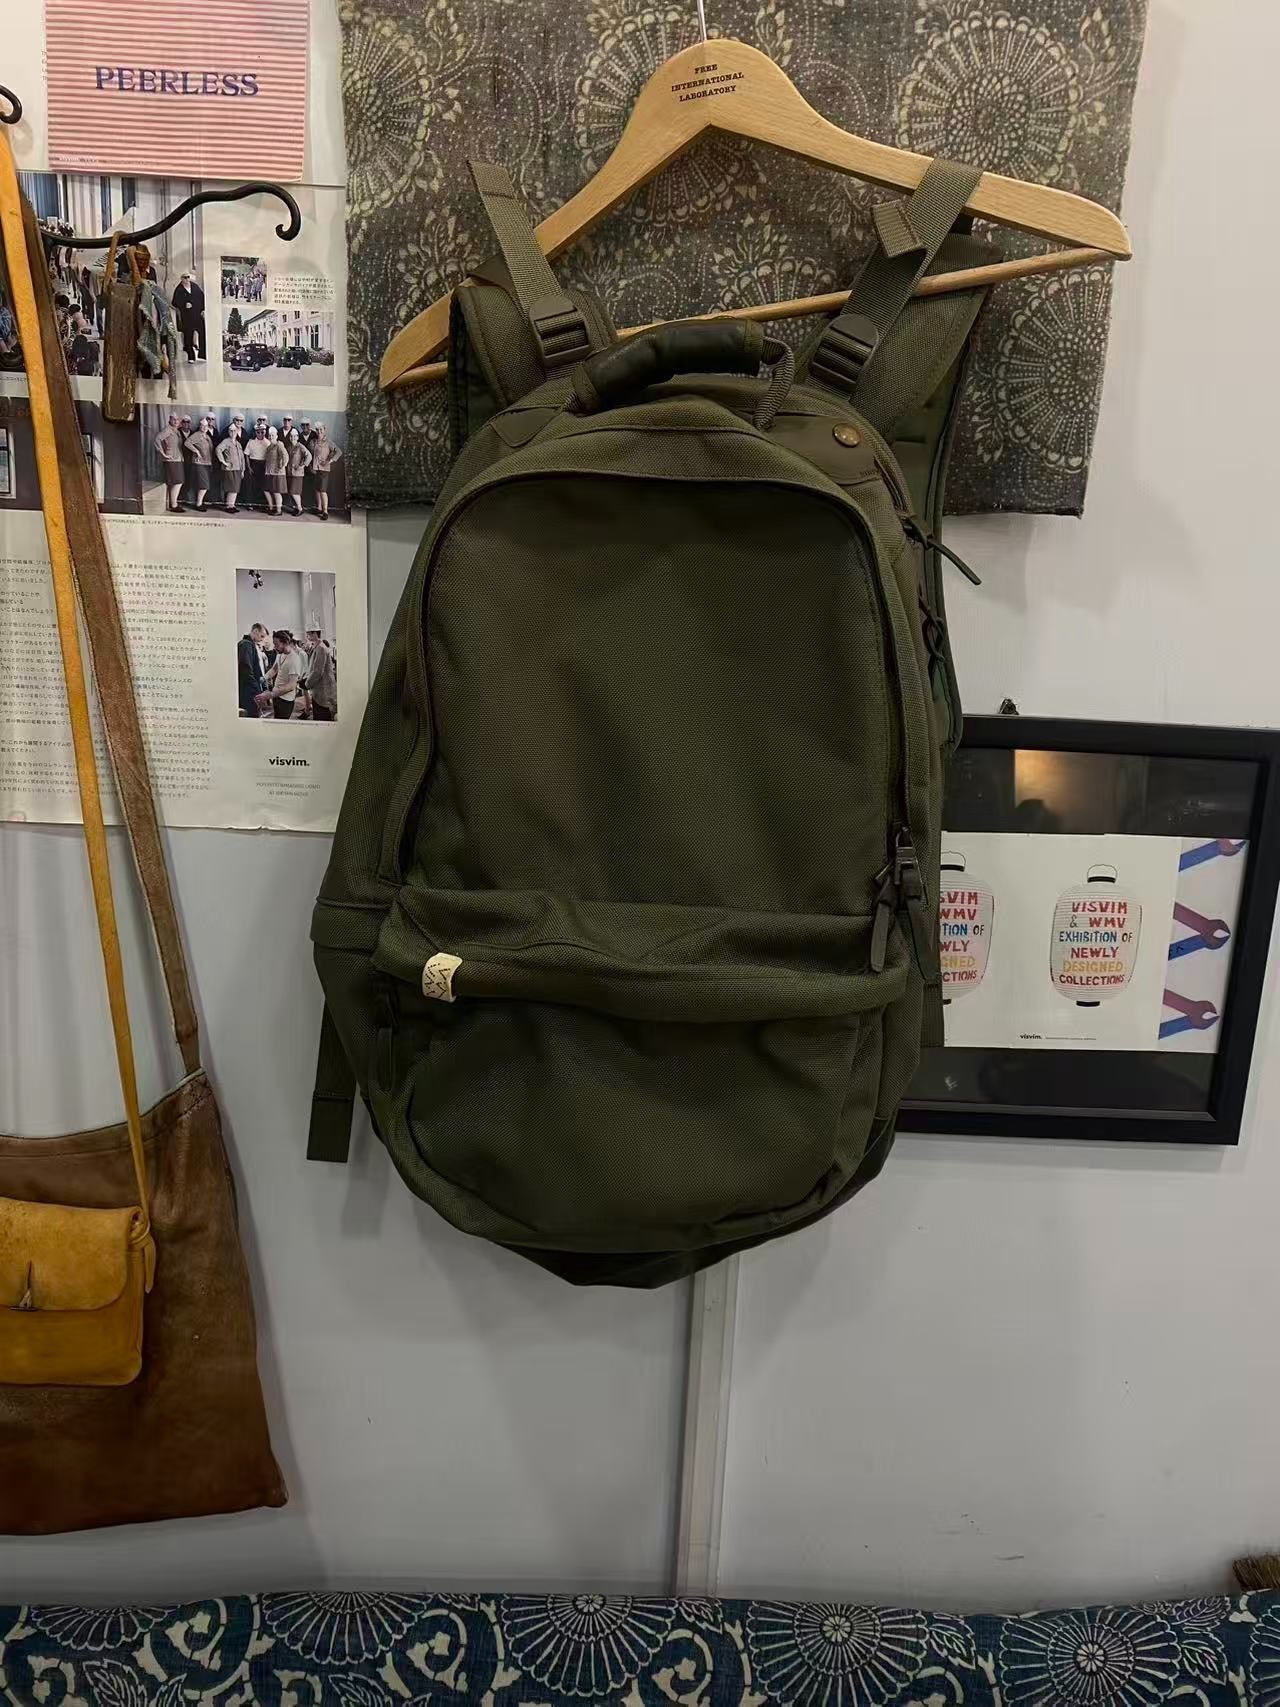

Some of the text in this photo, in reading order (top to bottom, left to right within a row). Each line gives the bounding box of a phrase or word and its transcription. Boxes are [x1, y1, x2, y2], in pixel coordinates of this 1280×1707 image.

[694, 64, 718, 73] FREE
[94, 66, 259, 97] PEERLESS
[671, 72, 744, 92] INTERNATIONAL
[268, 756, 310, 767] visvim.
[1071, 901, 1127, 914] VISVIM
[1069, 914, 1126, 928] & WMV
[973, 924, 984, 936] OF
[1059, 931, 1133, 943] EXHIBITION OF
[1071, 946, 1119, 958] NEWLY
[1063, 961, 1124, 972] DESIGNED
[1059, 974, 1124, 985] COLLECTIONS
